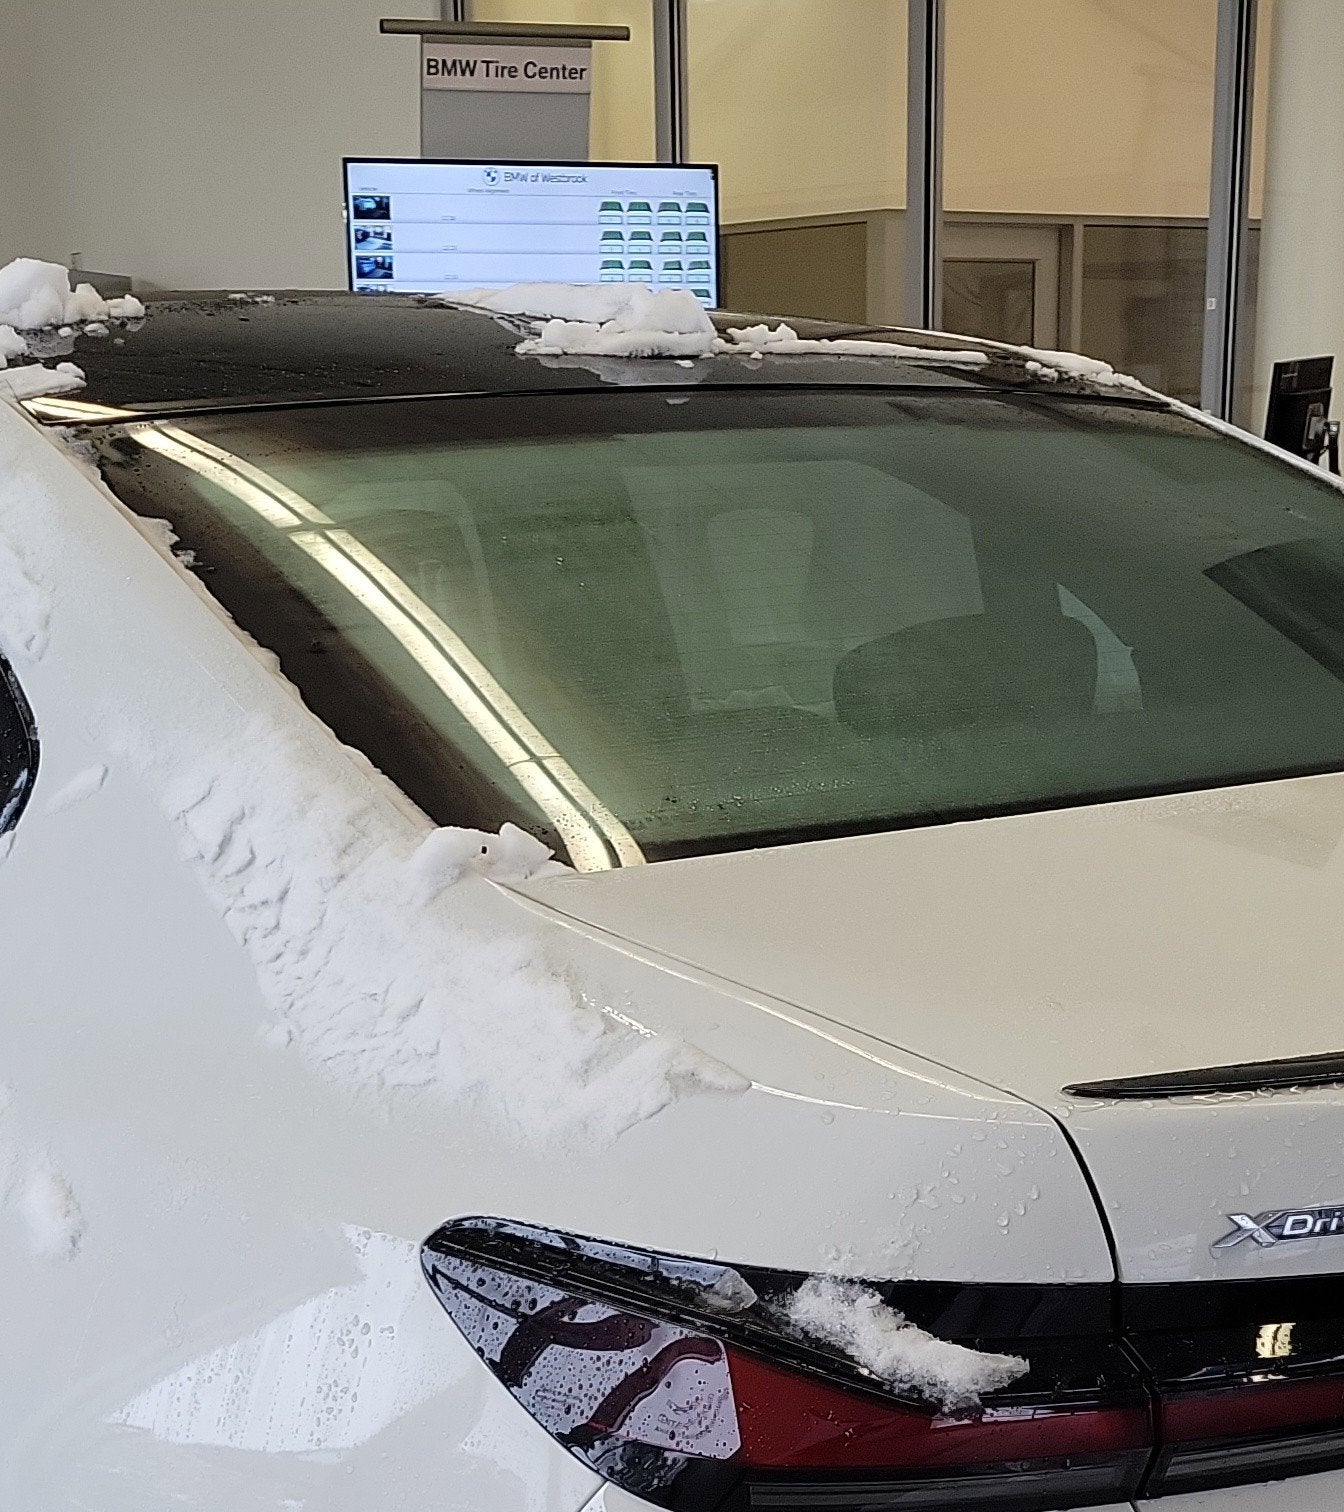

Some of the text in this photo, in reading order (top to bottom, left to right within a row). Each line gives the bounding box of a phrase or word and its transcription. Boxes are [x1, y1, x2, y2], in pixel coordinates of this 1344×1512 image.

[426, 58, 588, 80] BMW Tire Center
